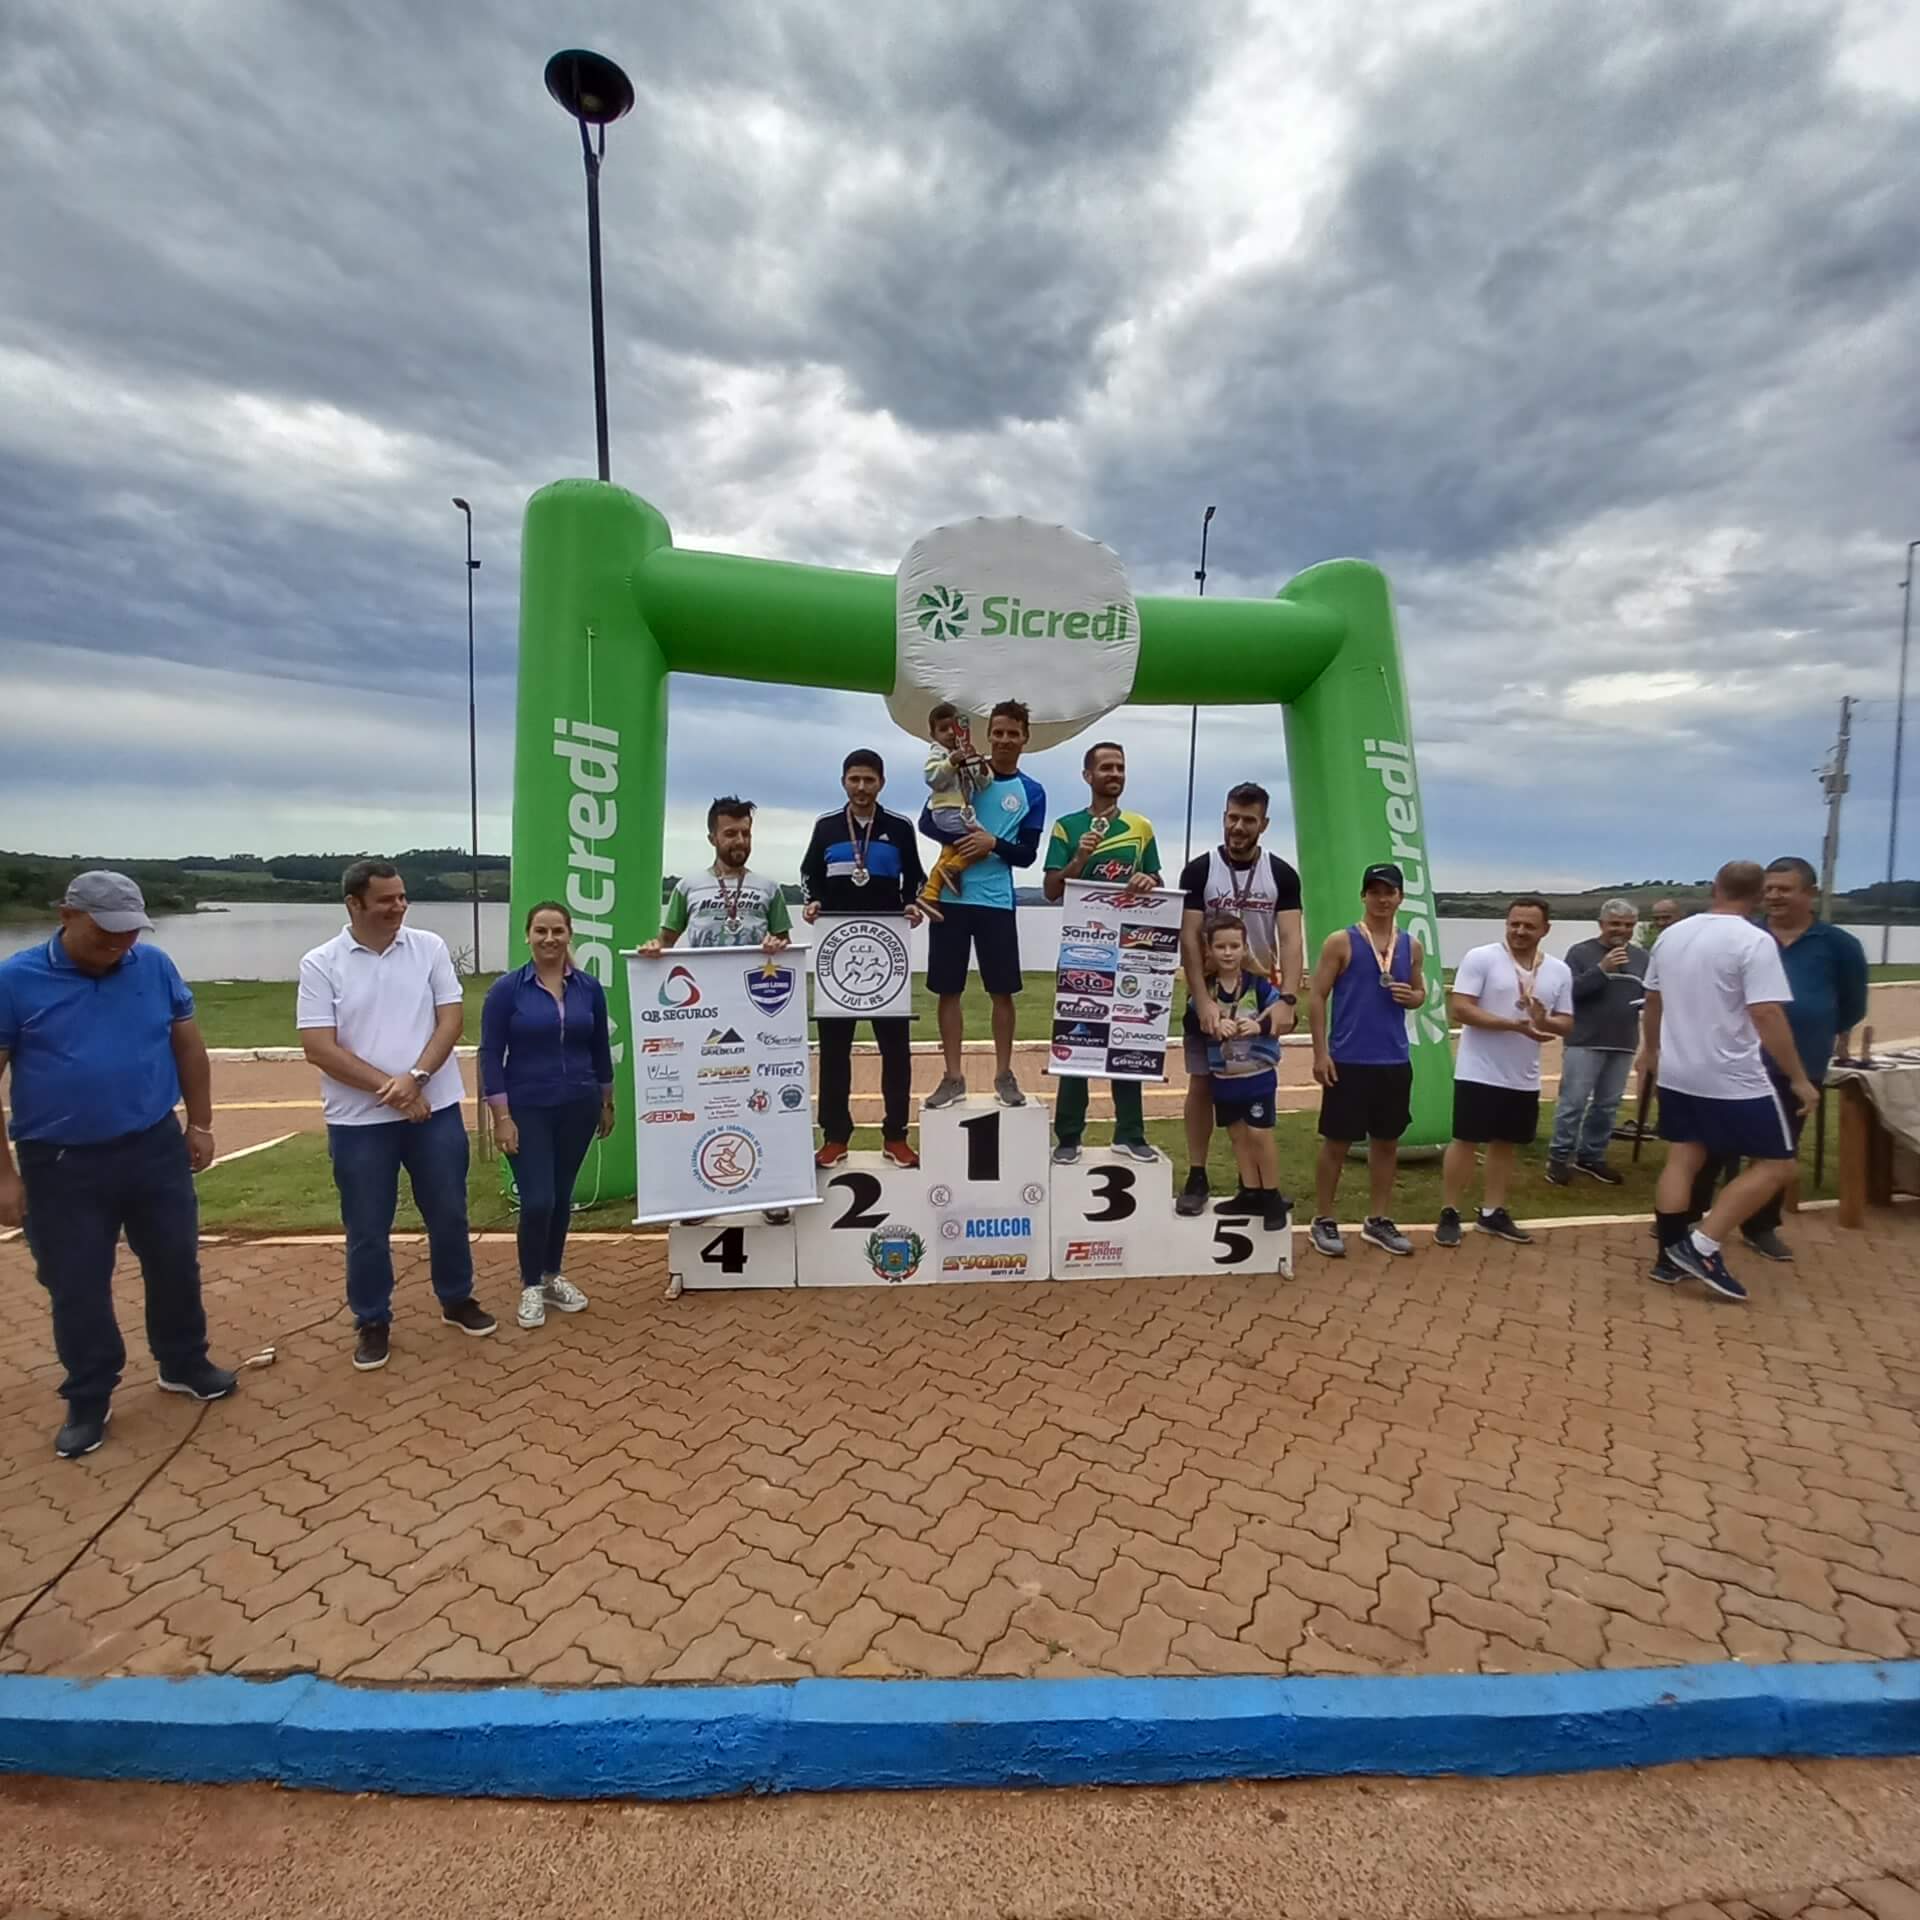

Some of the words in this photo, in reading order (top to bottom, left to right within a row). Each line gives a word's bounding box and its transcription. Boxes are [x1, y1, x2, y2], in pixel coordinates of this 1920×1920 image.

[981, 597, 1128, 642] Sicredi
[553, 717, 619, 988] Sicredi
[1364, 738, 1435, 956] Sicredi
[700, 899, 761, 910] Maraona
[818, 949, 834, 977] CLUBE
[826, 935, 843, 948] DE
[840, 925, 905, 963] CORREDORES
[893, 966, 905, 977] DE
[1128, 929, 1176, 944] SulCar
[663, 1007, 719, 1021] SEGUROS
[869, 993, 884, 1005] RS
[958, 1111, 1001, 1181] 1
[827, 1172, 891, 1229] 2
[1083, 1165, 1137, 1222] 3
[700, 1227, 748, 1273] 4
[966, 1217, 1031, 1238] ACELCOR
[1211, 1218, 1254, 1264] 5
